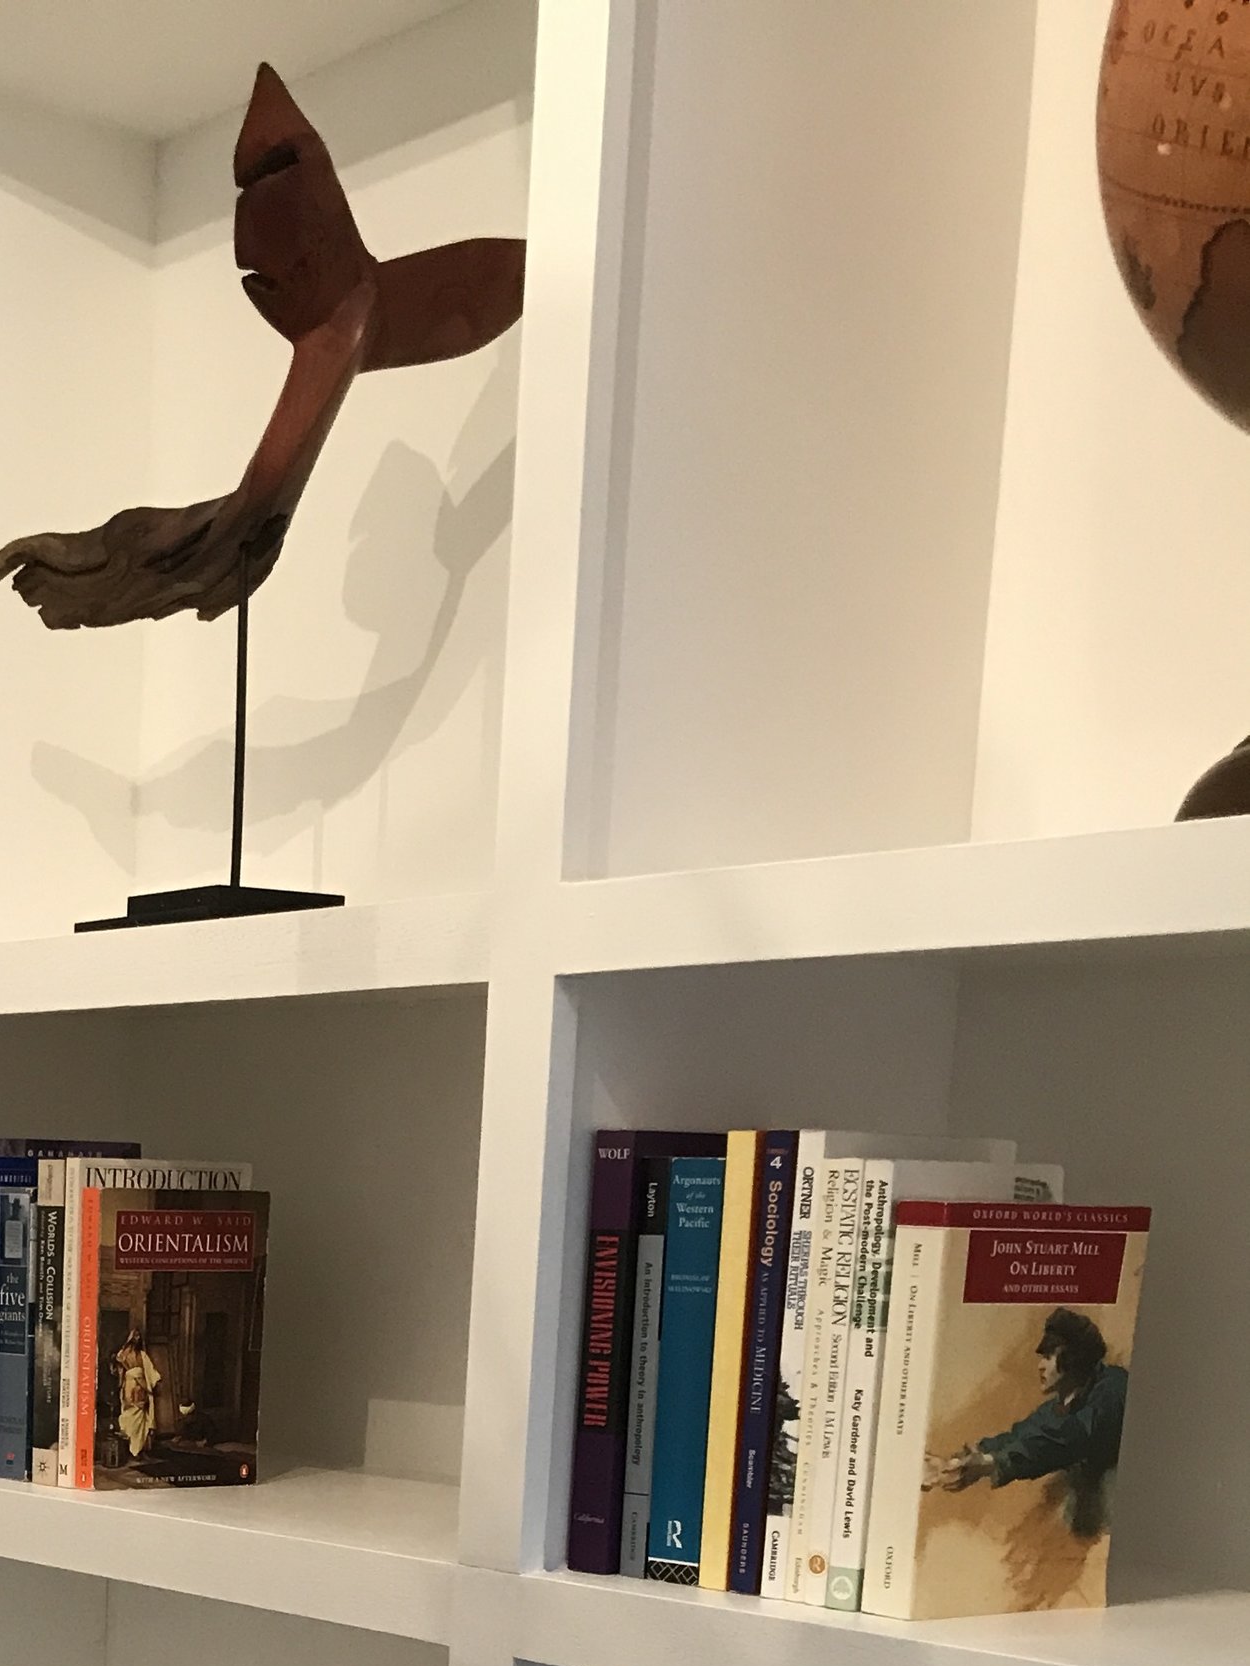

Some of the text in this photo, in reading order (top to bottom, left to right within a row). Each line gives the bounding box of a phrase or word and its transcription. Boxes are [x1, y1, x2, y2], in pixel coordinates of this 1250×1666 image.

[598, 1147, 631, 1160] WOLF
[770, 1155, 782, 1170] 4
[86, 1167, 242, 1190] INTRODUCTION
[672, 1175, 721, 1188] Argonauts
[799, 1166, 814, 1220] ORTNER
[646, 1182, 658, 1217] Layton
[676, 1203, 715, 1213] Western
[973, 1209, 1129, 1223] OXFORD WORLD'S CLASSICS
[46, 1211, 58, 1257] WORLDS
[121, 1215, 251, 1226] EDWARD W. SAID
[678, 1217, 711, 1228] Pacific
[761, 1180, 782, 1267] Sociology
[818, 1169, 840, 1287] Religion & Magic
[118, 1233, 249, 1252] ORIENTALISM
[120, 1257, 150, 1265] WESTERN
[151, 1257, 198, 1265] CONCEPTIONS
[223, 1257, 248, 1265] ORIENT
[853, 1180, 875, 1330] the Post-modern Challenge
[990, 1239, 1101, 1257] JOHN STUART MILL
[6, 1272, 19, 1284] the
[761, 1271, 770, 1283] AS
[786, 1231, 801, 1310] THEIR RITUALS
[794, 1230, 812, 1330] SHERPAS THROUGH
[864, 1179, 888, 1358] Anthropology, Development and
[1009, 1261, 1077, 1276] ON LIBERTY
[0, 1283, 26, 1307] five
[45, 1266, 56, 1320] COLLISION
[757, 1286, 768, 1325] APPLIED
[1003, 1284, 1079, 1294] AND OTHER ESSAYS
[583, 1235, 620, 1427] ENVISIONING POWER
[821, 1169, 860, 1459] ECSTATIC RELIGION Second Edition Lewis
[756, 1328, 766, 1343] TO
[811, 1309, 825, 1376] Approaches
[81, 1316, 91, 1416] ORIENTALISM
[631, 1262, 653, 1466] An introduction to theory in anthropology
[903, 1346, 912, 1367] AND
[750, 1346, 767, 1414] MEDICINE
[900, 1367, 910, 1400] OTHER
[805, 1396, 817, 1446] Theories
[896, 1402, 906, 1436] ESSAYS
[746, 1449, 756, 1489] Scambler
[842, 1389, 864, 1539] Katy Gardner and David Lewis
[797, 1462, 809, 1535] CUNNINGHAM
[629, 1511, 638, 1561] CAMBRIDGE
[739, 1523, 750, 1574] SAUNDERS
[768, 1530, 781, 1581] CAMBRIDGE
[792, 1557, 803, 1594] Edinburgh
[884, 1546, 894, 1590] OXFORD
